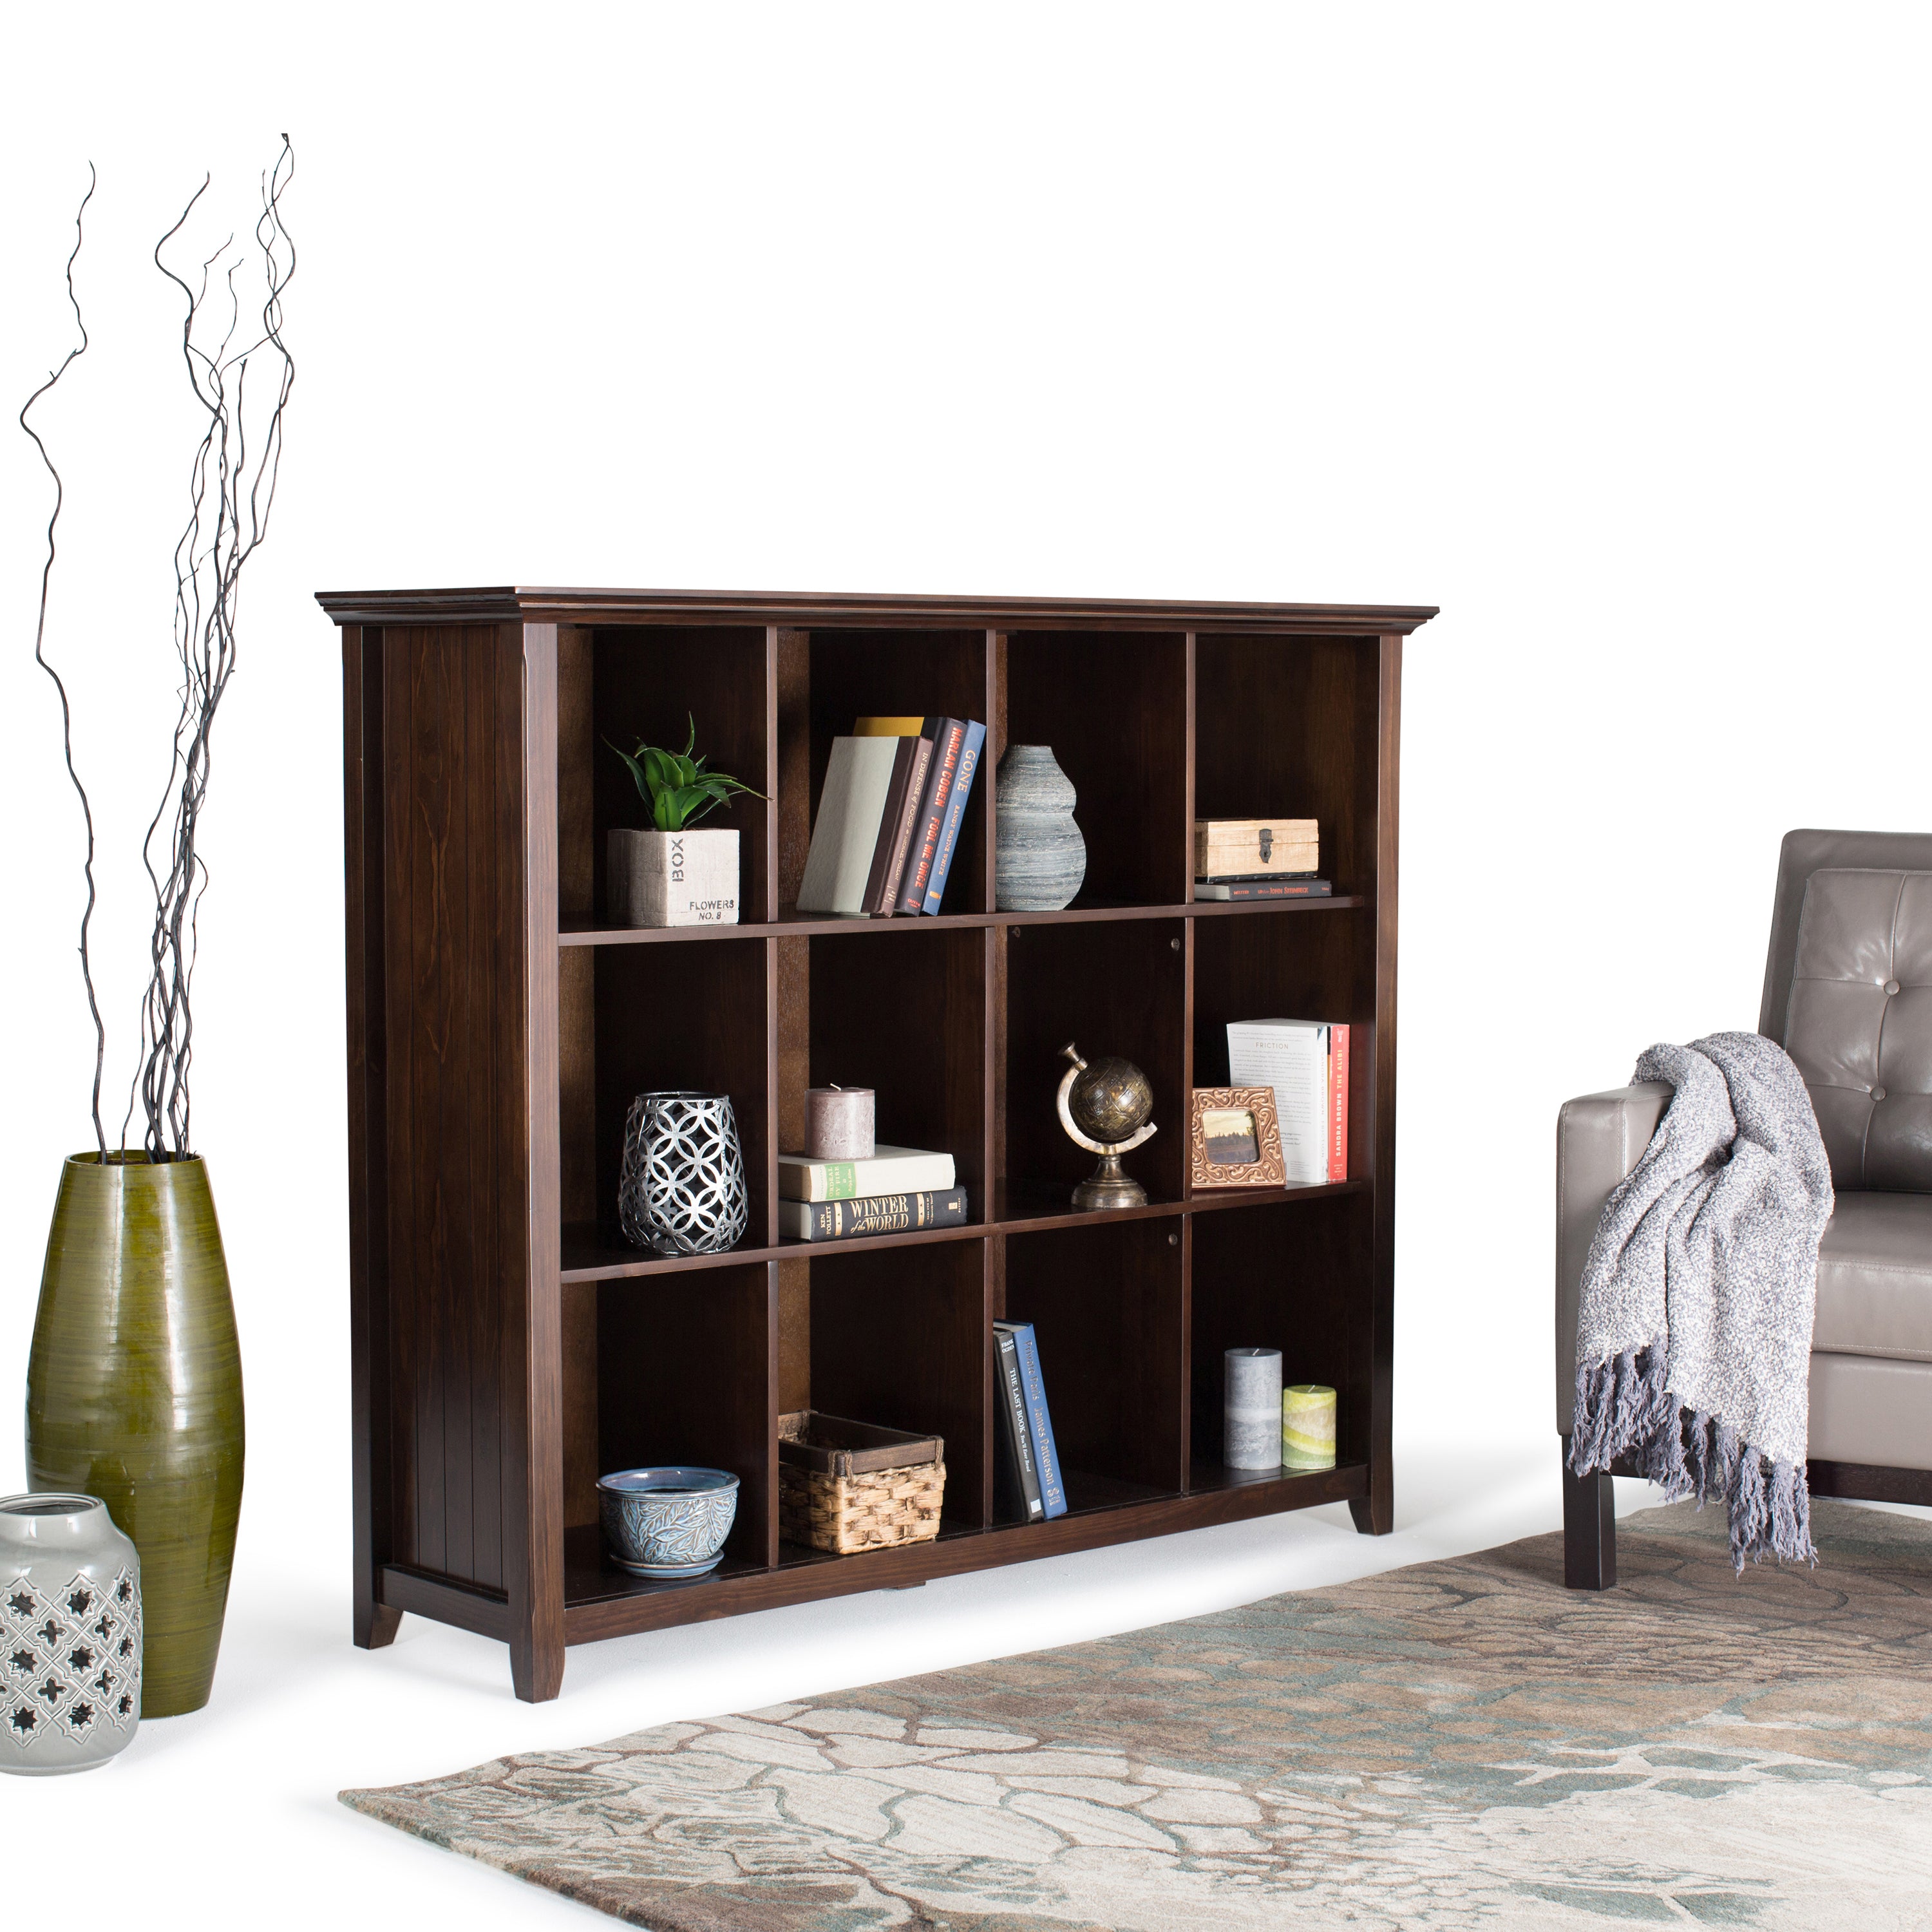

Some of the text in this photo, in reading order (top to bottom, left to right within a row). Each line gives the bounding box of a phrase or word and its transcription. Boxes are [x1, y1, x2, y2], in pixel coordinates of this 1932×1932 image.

[934, 726, 963, 808] HARLAN COBEN
[957, 750, 976, 793] GONE
[907, 752, 929, 827] IN DEFENSE of FOOD
[672, 838, 684, 882] BOX
[914, 817, 940, 889] FOOL ME ONCE
[689, 899, 734, 911] FLOWERS
[698, 911, 721, 921] NO. 8
[849, 1195, 909, 1218] WINTER
[850, 1220, 861, 1234] of
[865, 1213, 909, 1232] WORLD
[1001, 1338, 1014, 1348] FRANK
[1002, 1344, 1015, 1353] OGDEN
[1024, 1340, 1041, 1401] Private Paris
[1013, 1387, 1022, 1408] LAST
[1016, 1409, 1026, 1434] BOOK
[1034, 1406, 1054, 1485] James Patterson
